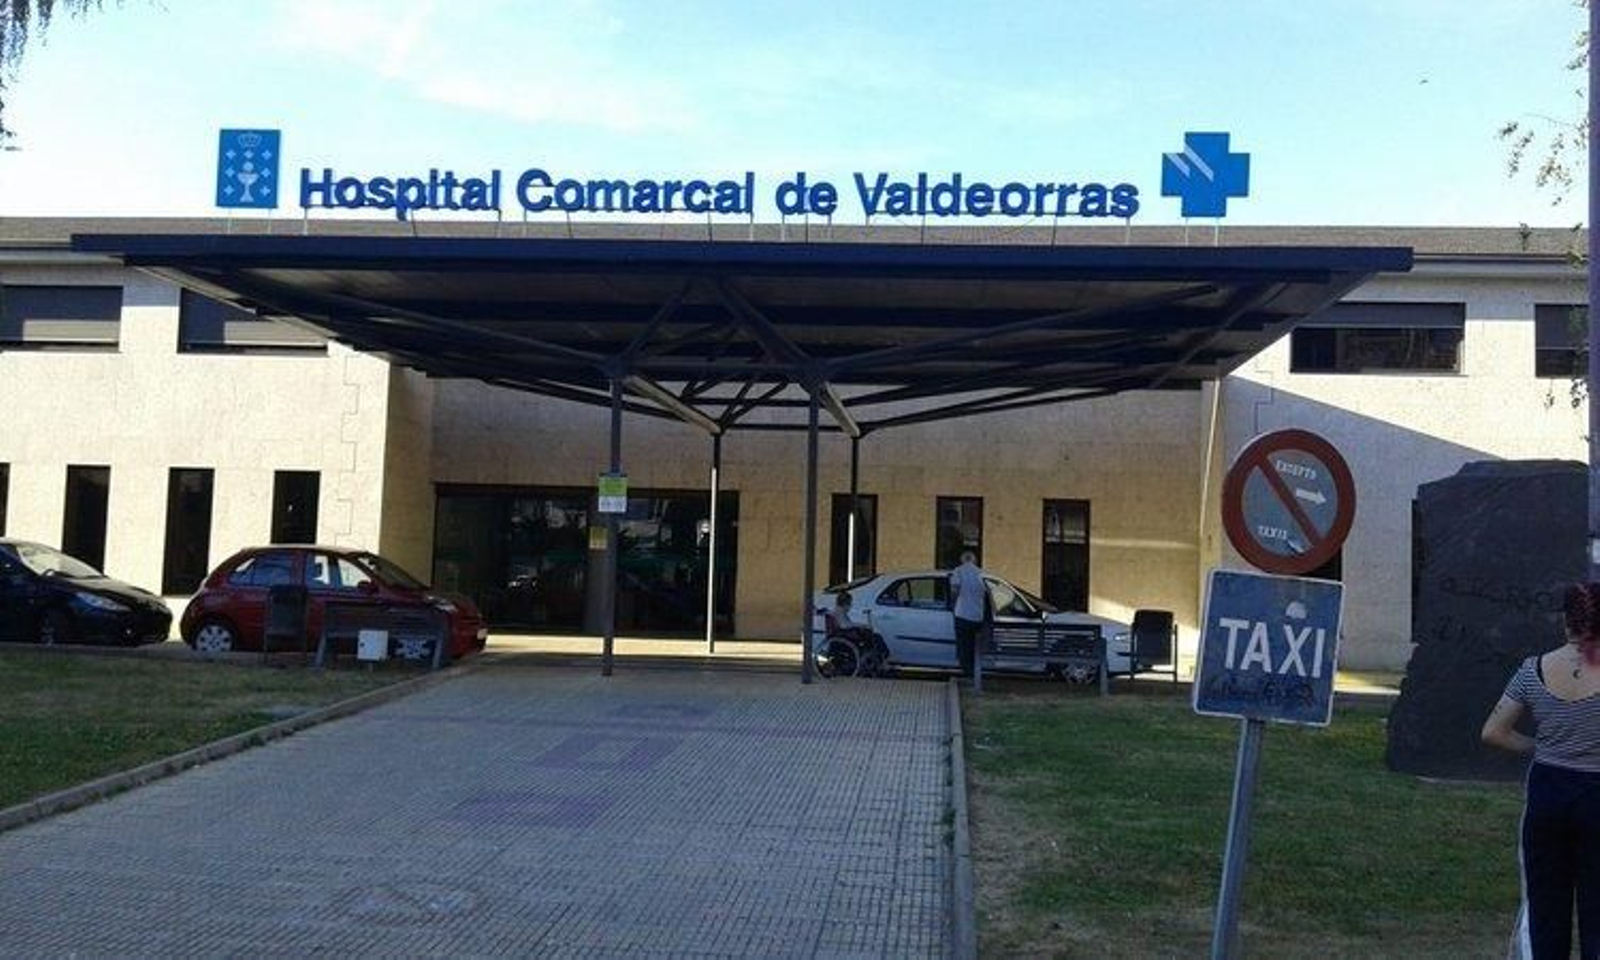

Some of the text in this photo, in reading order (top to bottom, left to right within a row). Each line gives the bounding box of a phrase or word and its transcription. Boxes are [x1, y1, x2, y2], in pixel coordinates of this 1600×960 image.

[301, 168, 1140, 220] Hospital Comarcal de Valdeorras
[1219, 617, 1326, 679] TAXI
